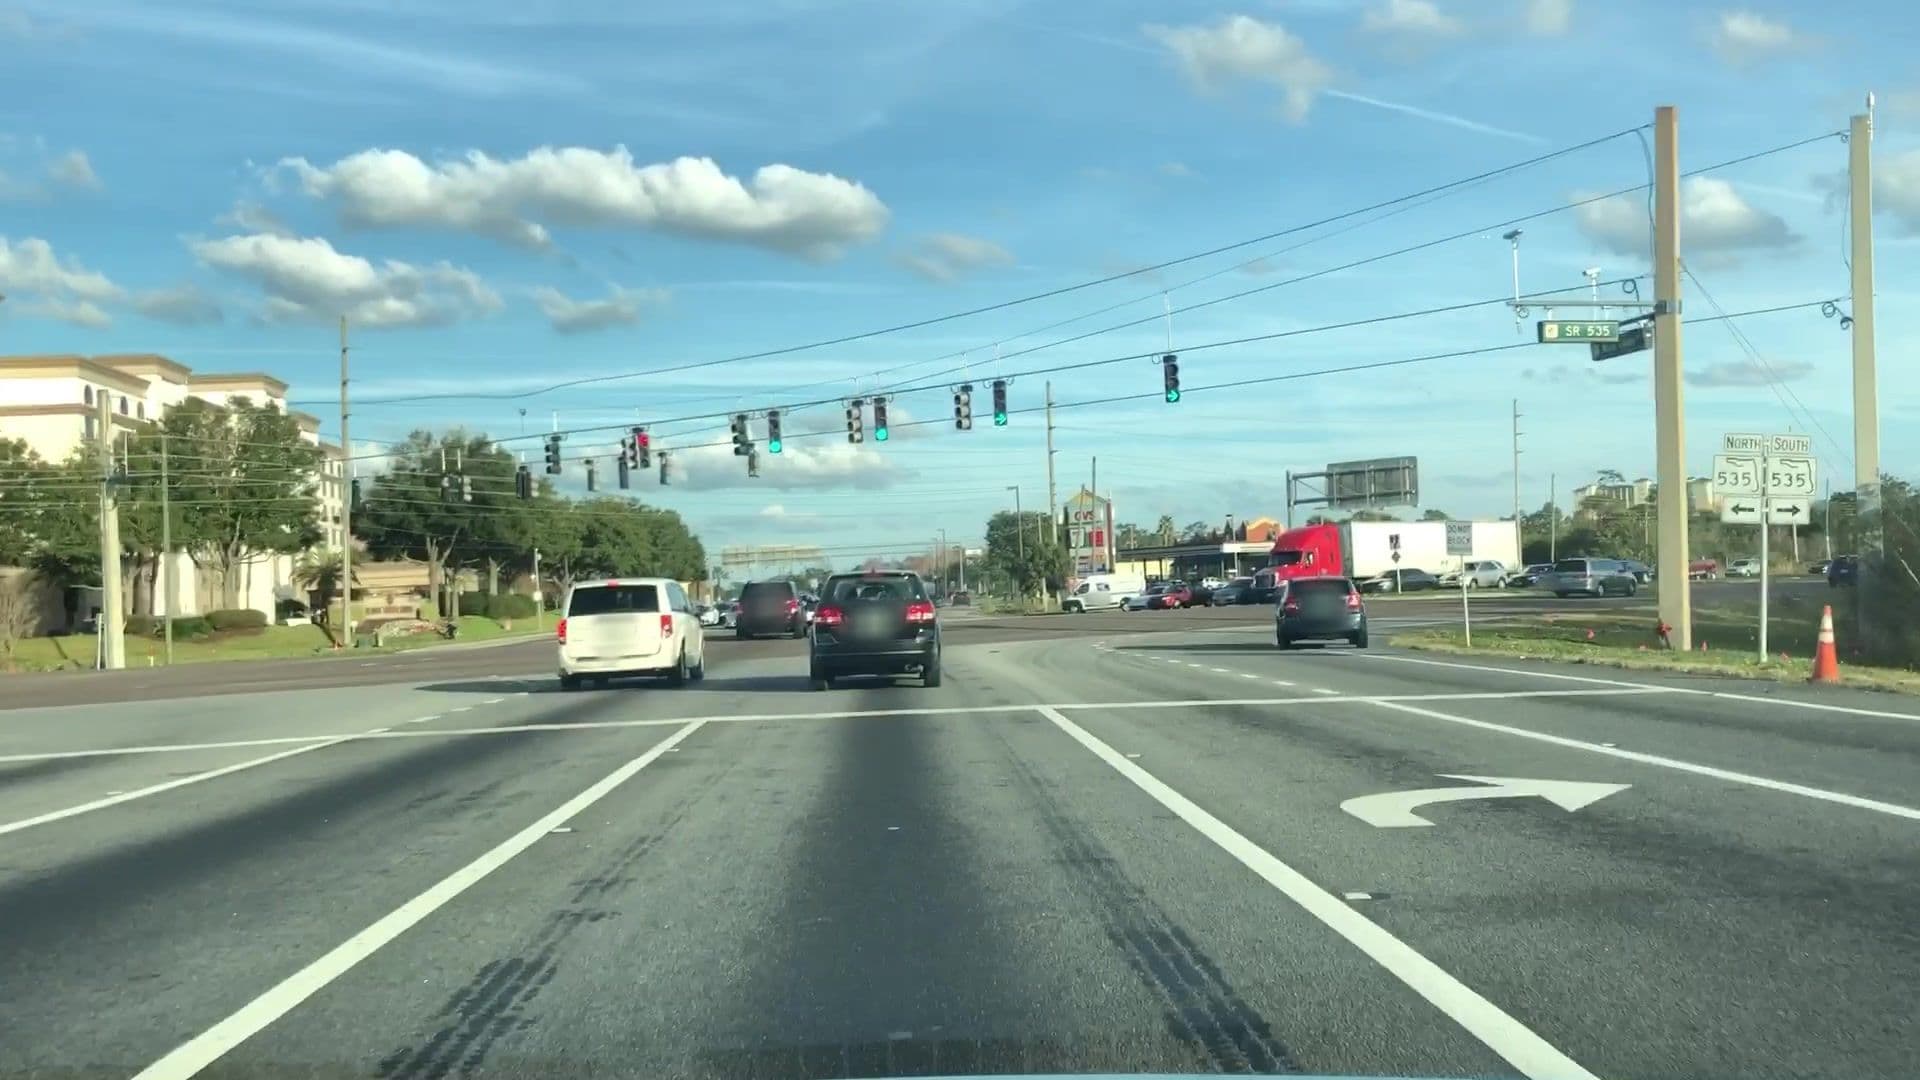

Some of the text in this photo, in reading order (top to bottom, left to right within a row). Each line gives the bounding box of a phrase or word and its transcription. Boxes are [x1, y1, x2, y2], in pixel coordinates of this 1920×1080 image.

[1565, 325, 1610, 337] SR 535
[1726, 436, 1760, 449] NORTH
[1774, 437, 1809, 451] SOUTH
[1718, 471, 1751, 486] 535
[1772, 472, 1805, 487] 535
[1074, 510, 1095, 521] CVS
